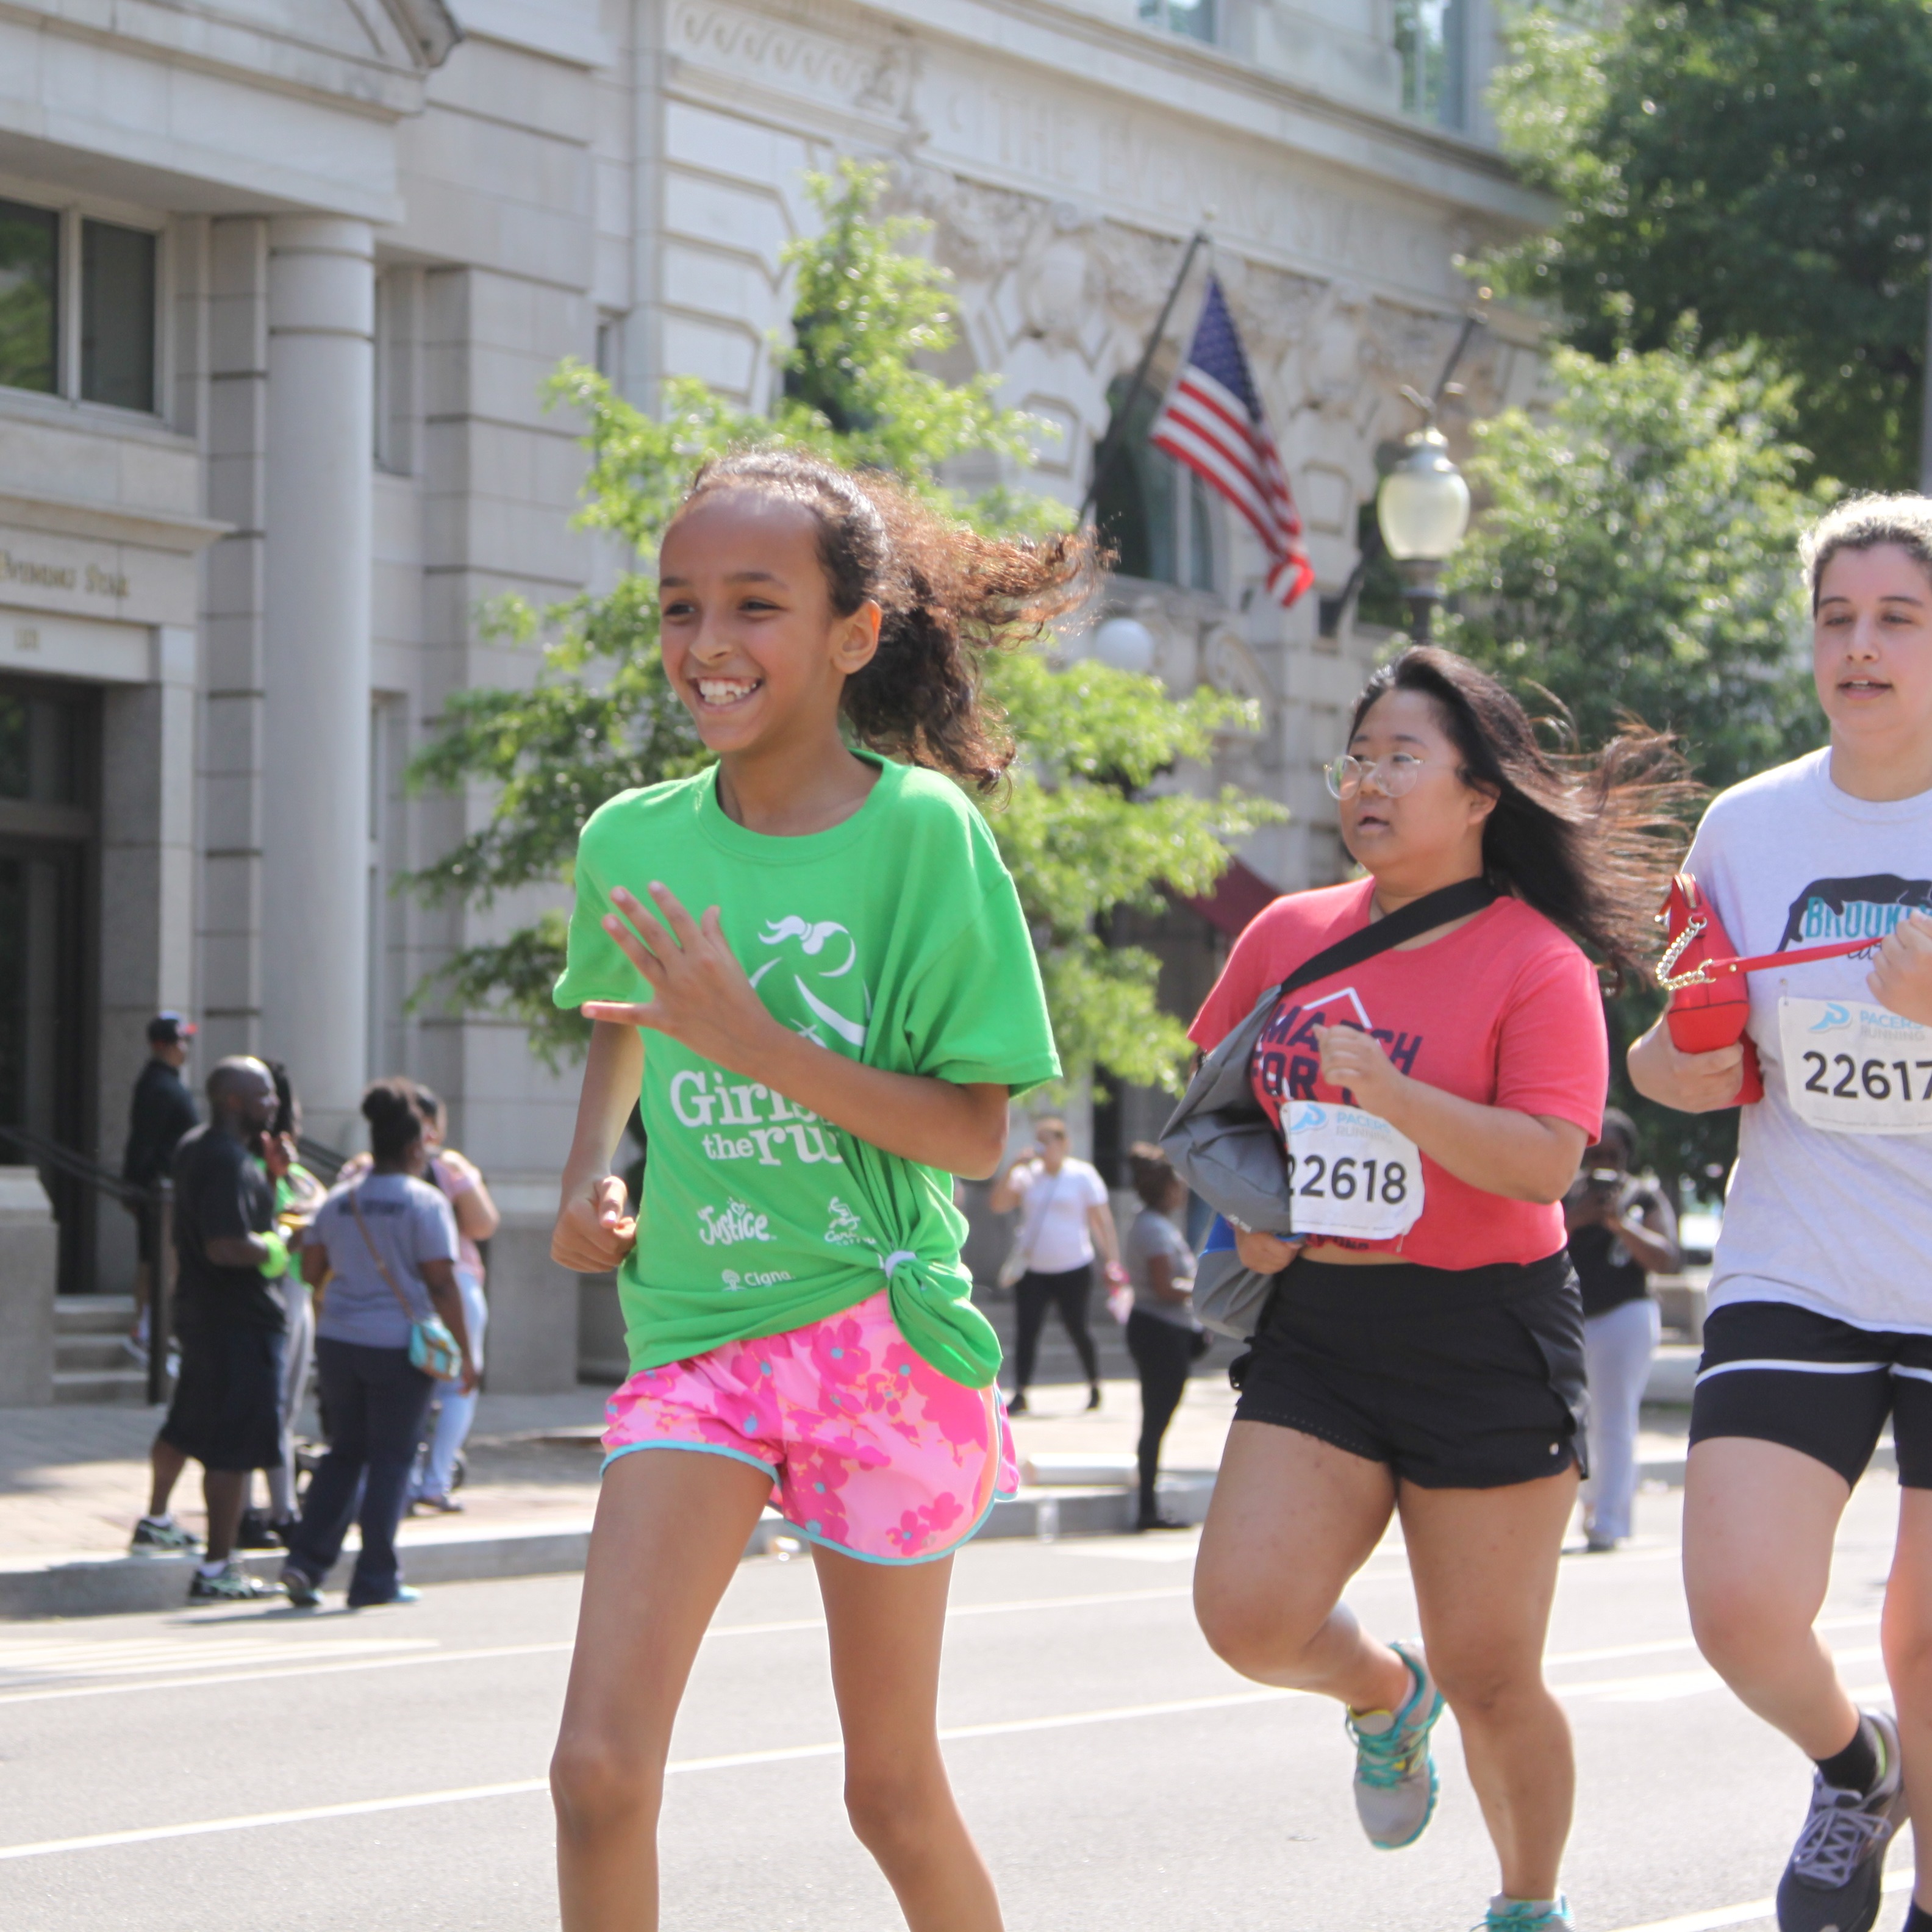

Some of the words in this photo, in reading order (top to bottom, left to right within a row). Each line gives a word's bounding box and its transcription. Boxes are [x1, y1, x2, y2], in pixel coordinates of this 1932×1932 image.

[1261, 1003, 1423, 1075] MAH
[1803, 1051, 1932, 1101] 22617
[703, 1133, 754, 1160] the
[749, 1124, 844, 1166] ru
[698, 1198, 770, 1245] Justice
[745, 1271, 792, 1287] Cigna
